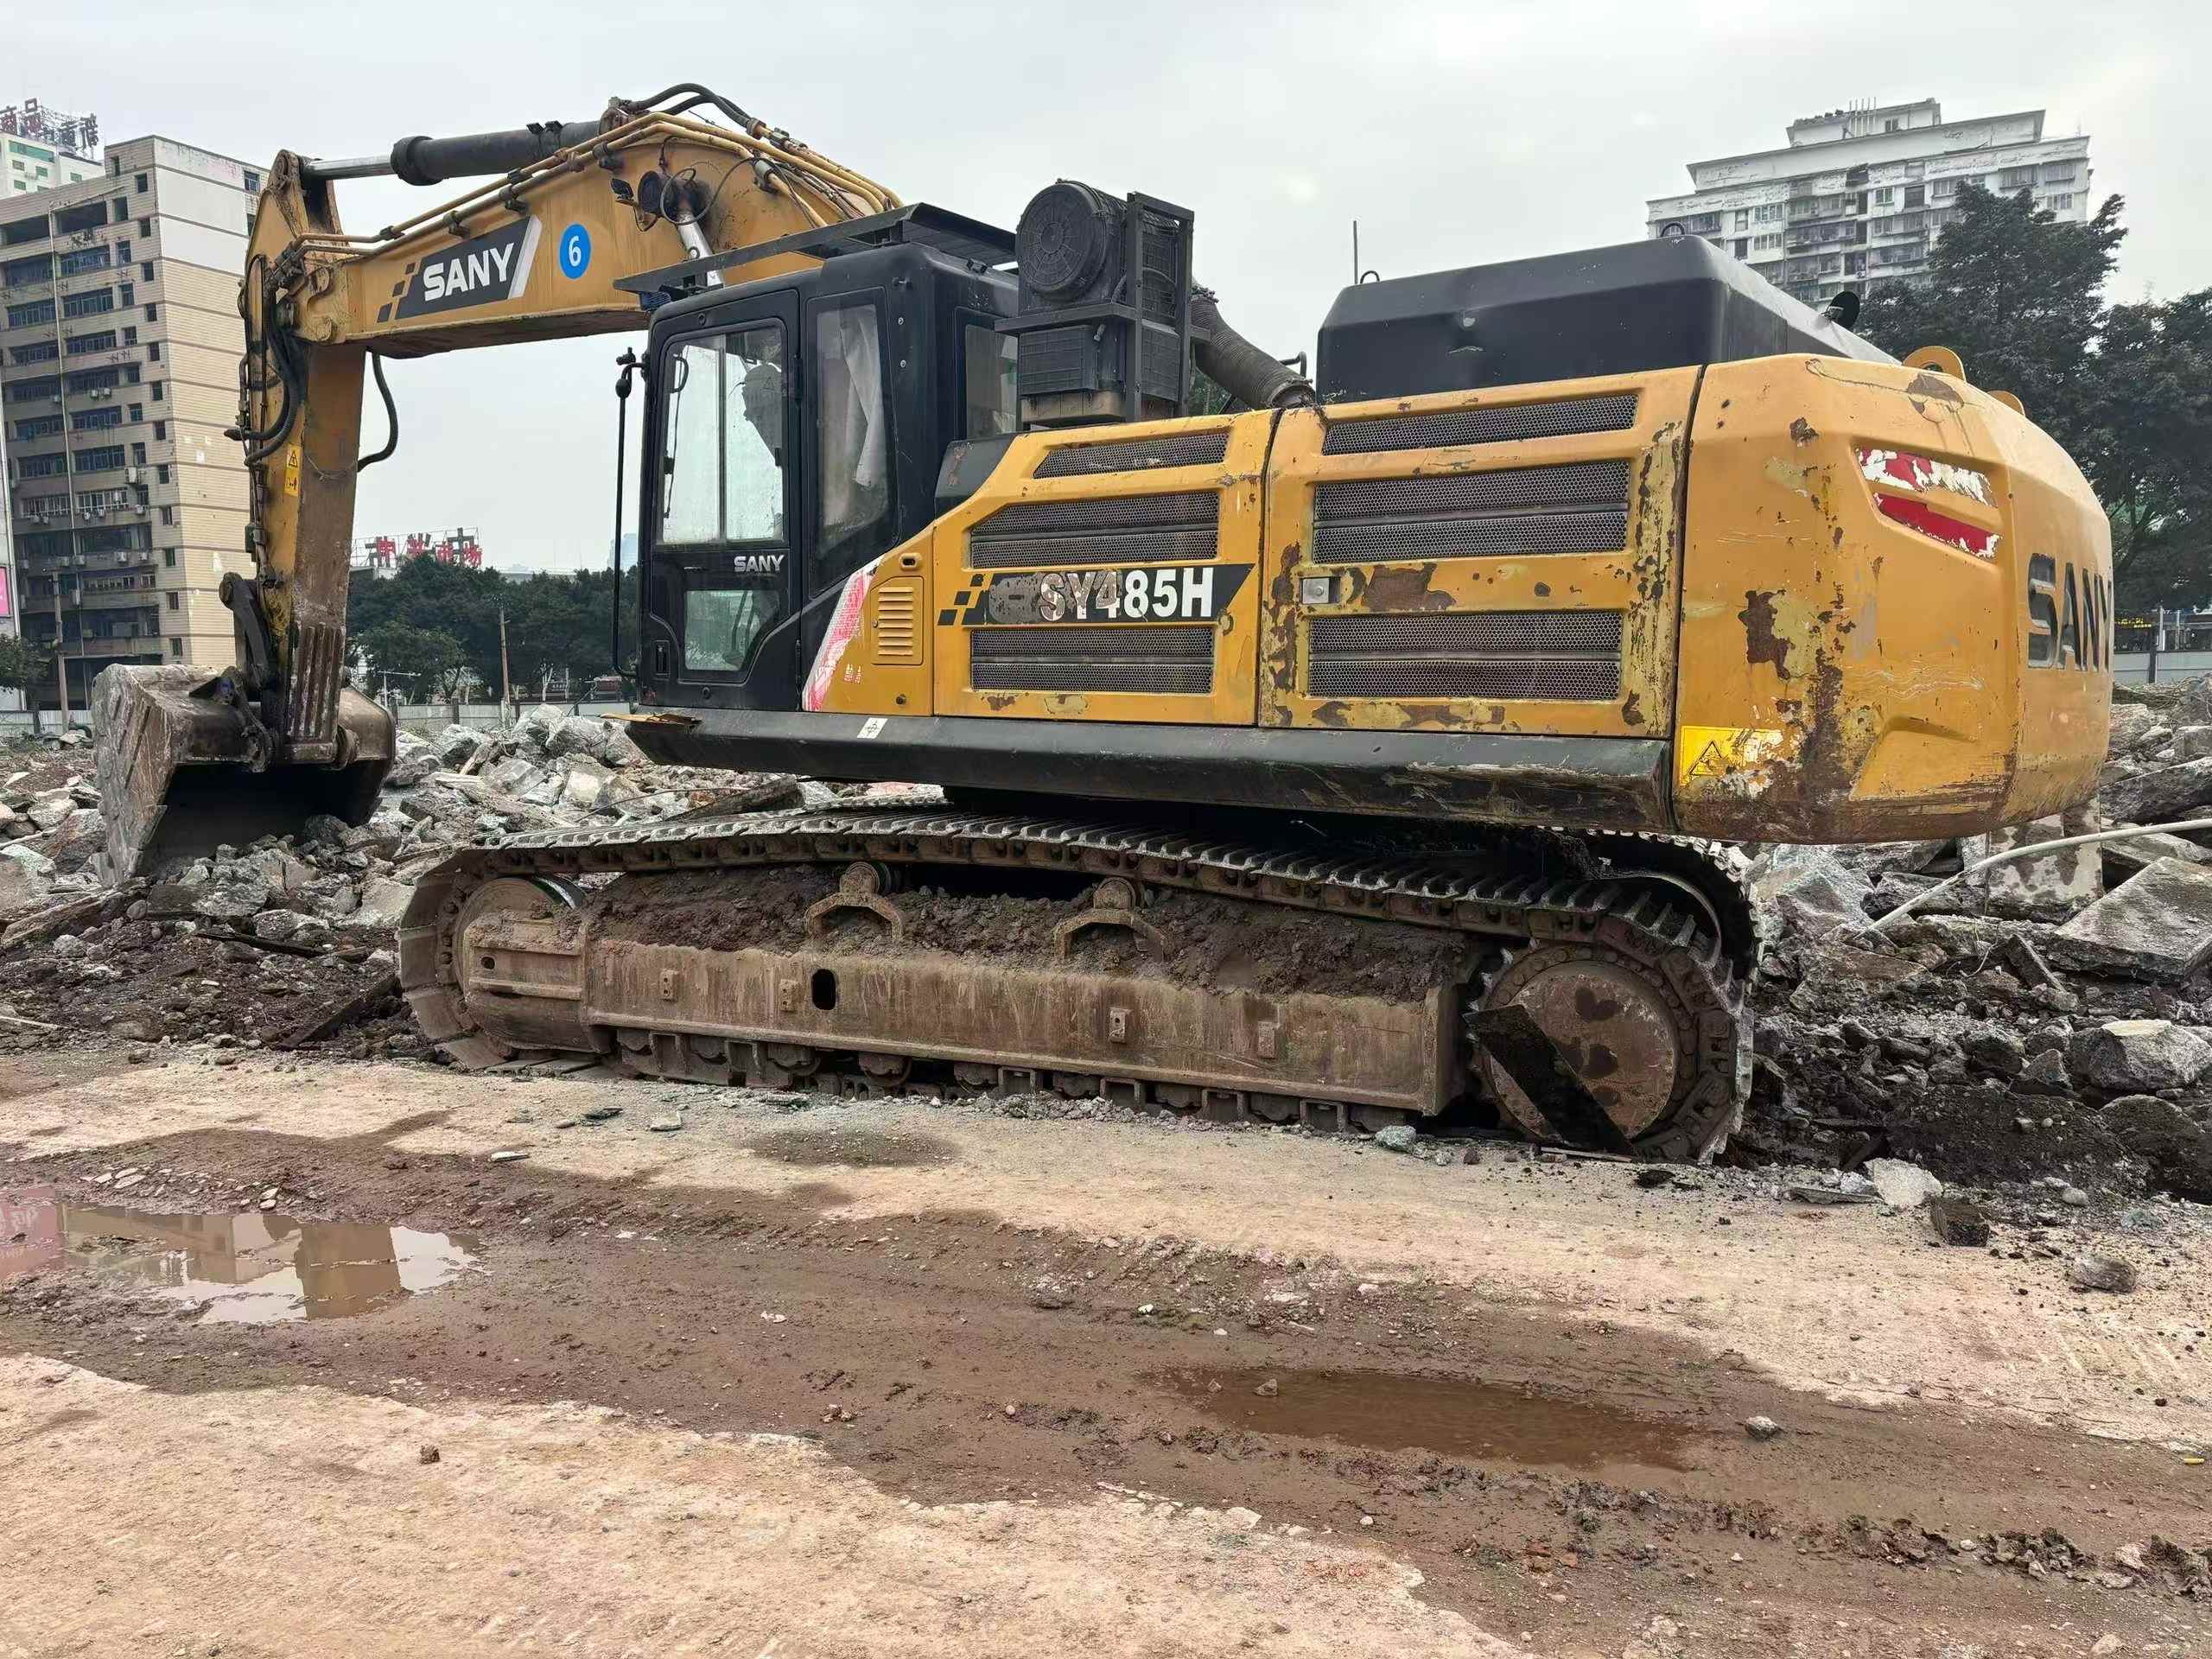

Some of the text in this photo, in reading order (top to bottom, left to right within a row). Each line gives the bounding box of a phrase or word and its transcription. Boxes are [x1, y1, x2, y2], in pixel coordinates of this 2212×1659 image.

[423, 242, 514, 302] SANY
[568, 235, 582, 268] 6
[734, 554, 784, 573] SANY
[1039, 568, 1214, 621] SY485H
[2028, 553, 2112, 671] SANY
